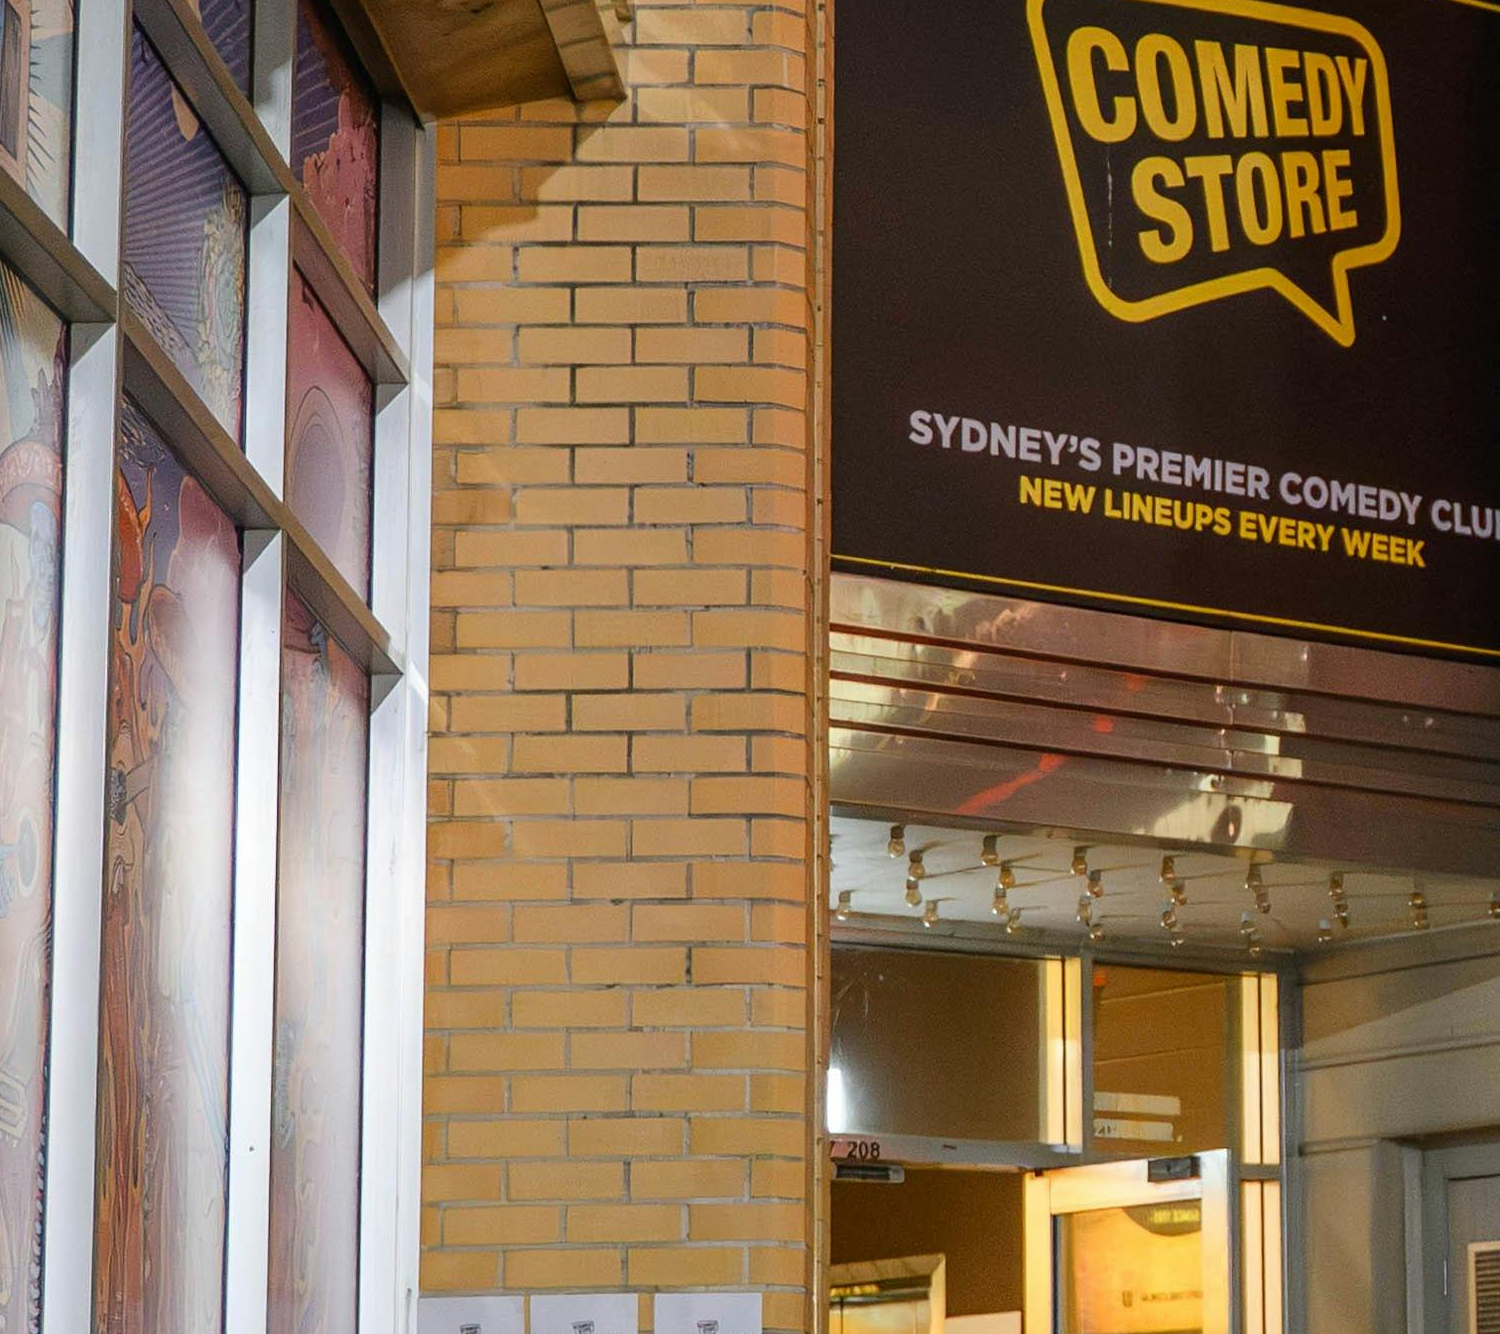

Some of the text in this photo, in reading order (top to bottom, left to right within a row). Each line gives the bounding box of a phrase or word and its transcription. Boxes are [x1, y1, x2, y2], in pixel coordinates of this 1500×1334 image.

[1066, 26, 1368, 144] COMEDY
[1131, 149, 1358, 264] STORE
[908, 410, 1101, 472] SYDNEY'S
[1112, 442, 1270, 501] PREMIER
[1280, 472, 1423, 526] COMEDY
[1019, 475, 1427, 568] NEW LINEUPS EVERY WEEK
